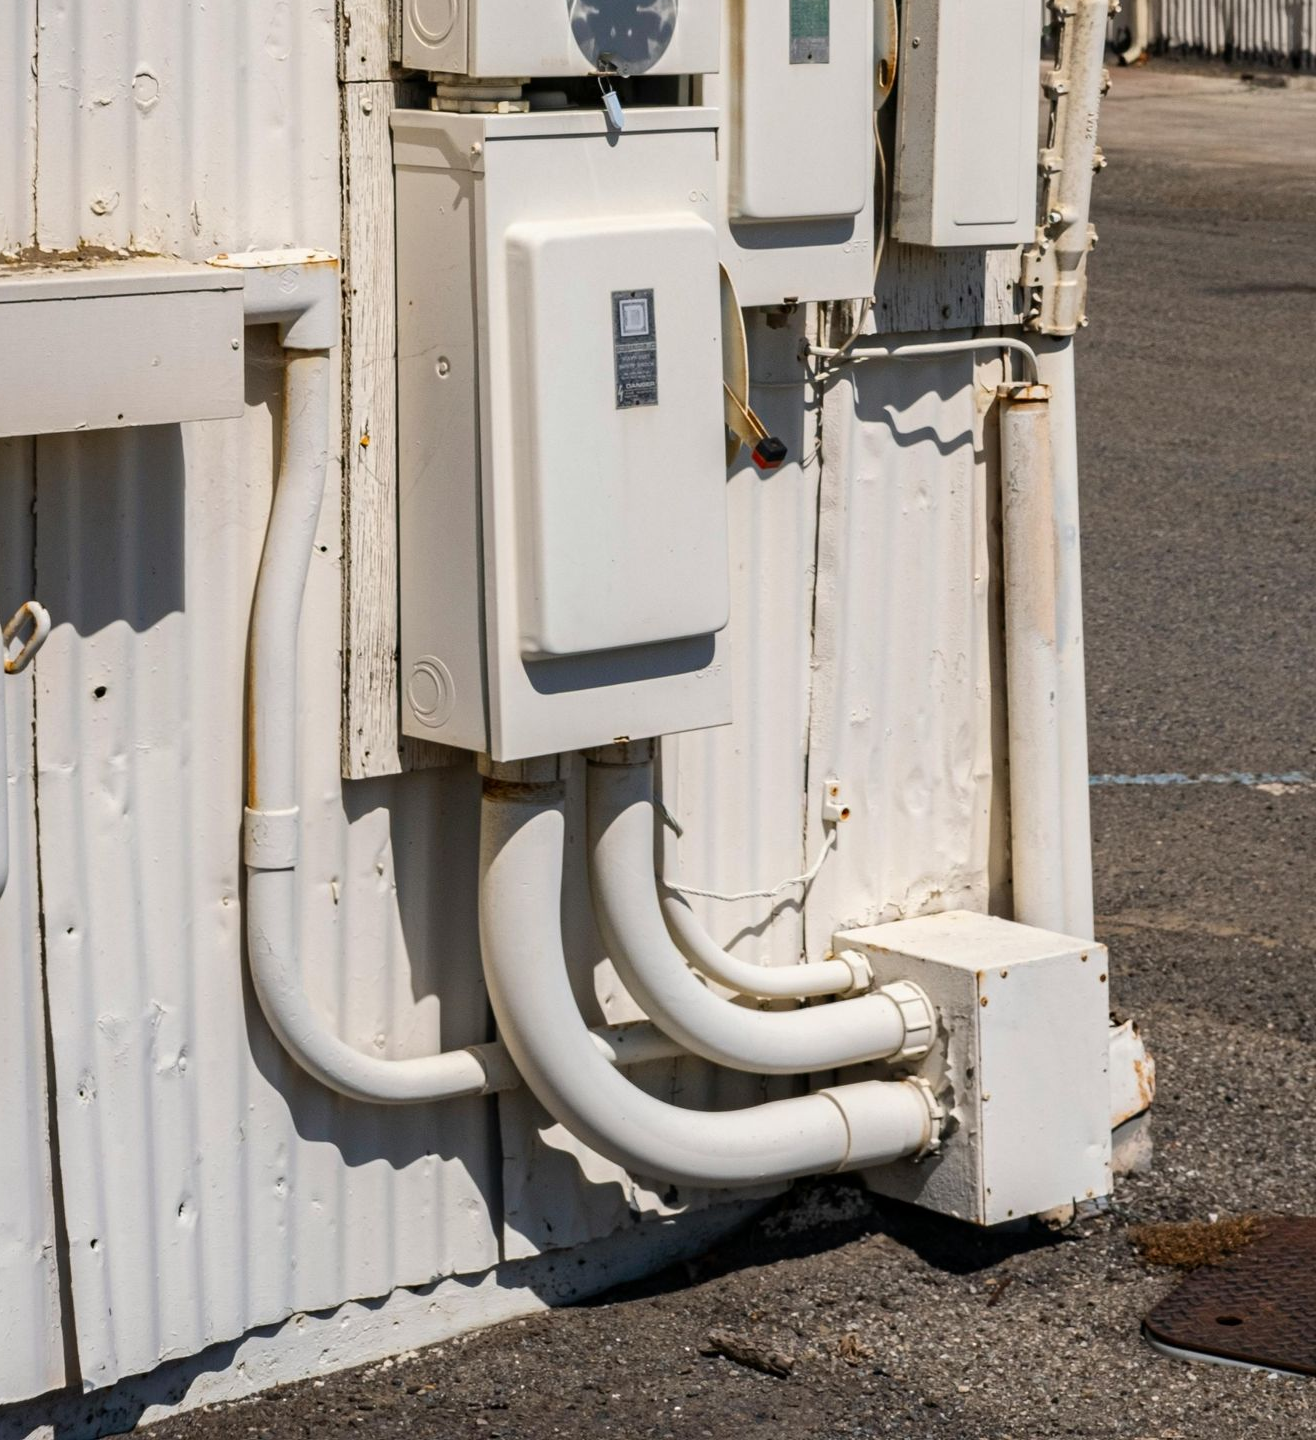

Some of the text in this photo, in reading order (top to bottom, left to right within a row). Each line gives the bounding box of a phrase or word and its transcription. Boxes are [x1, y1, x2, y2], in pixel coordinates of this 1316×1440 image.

[689, 190, 709, 202] ON
[843, 240, 868, 253] OFF
[623, 304, 644, 330] D
[625, 381, 655, 389] DANGER
